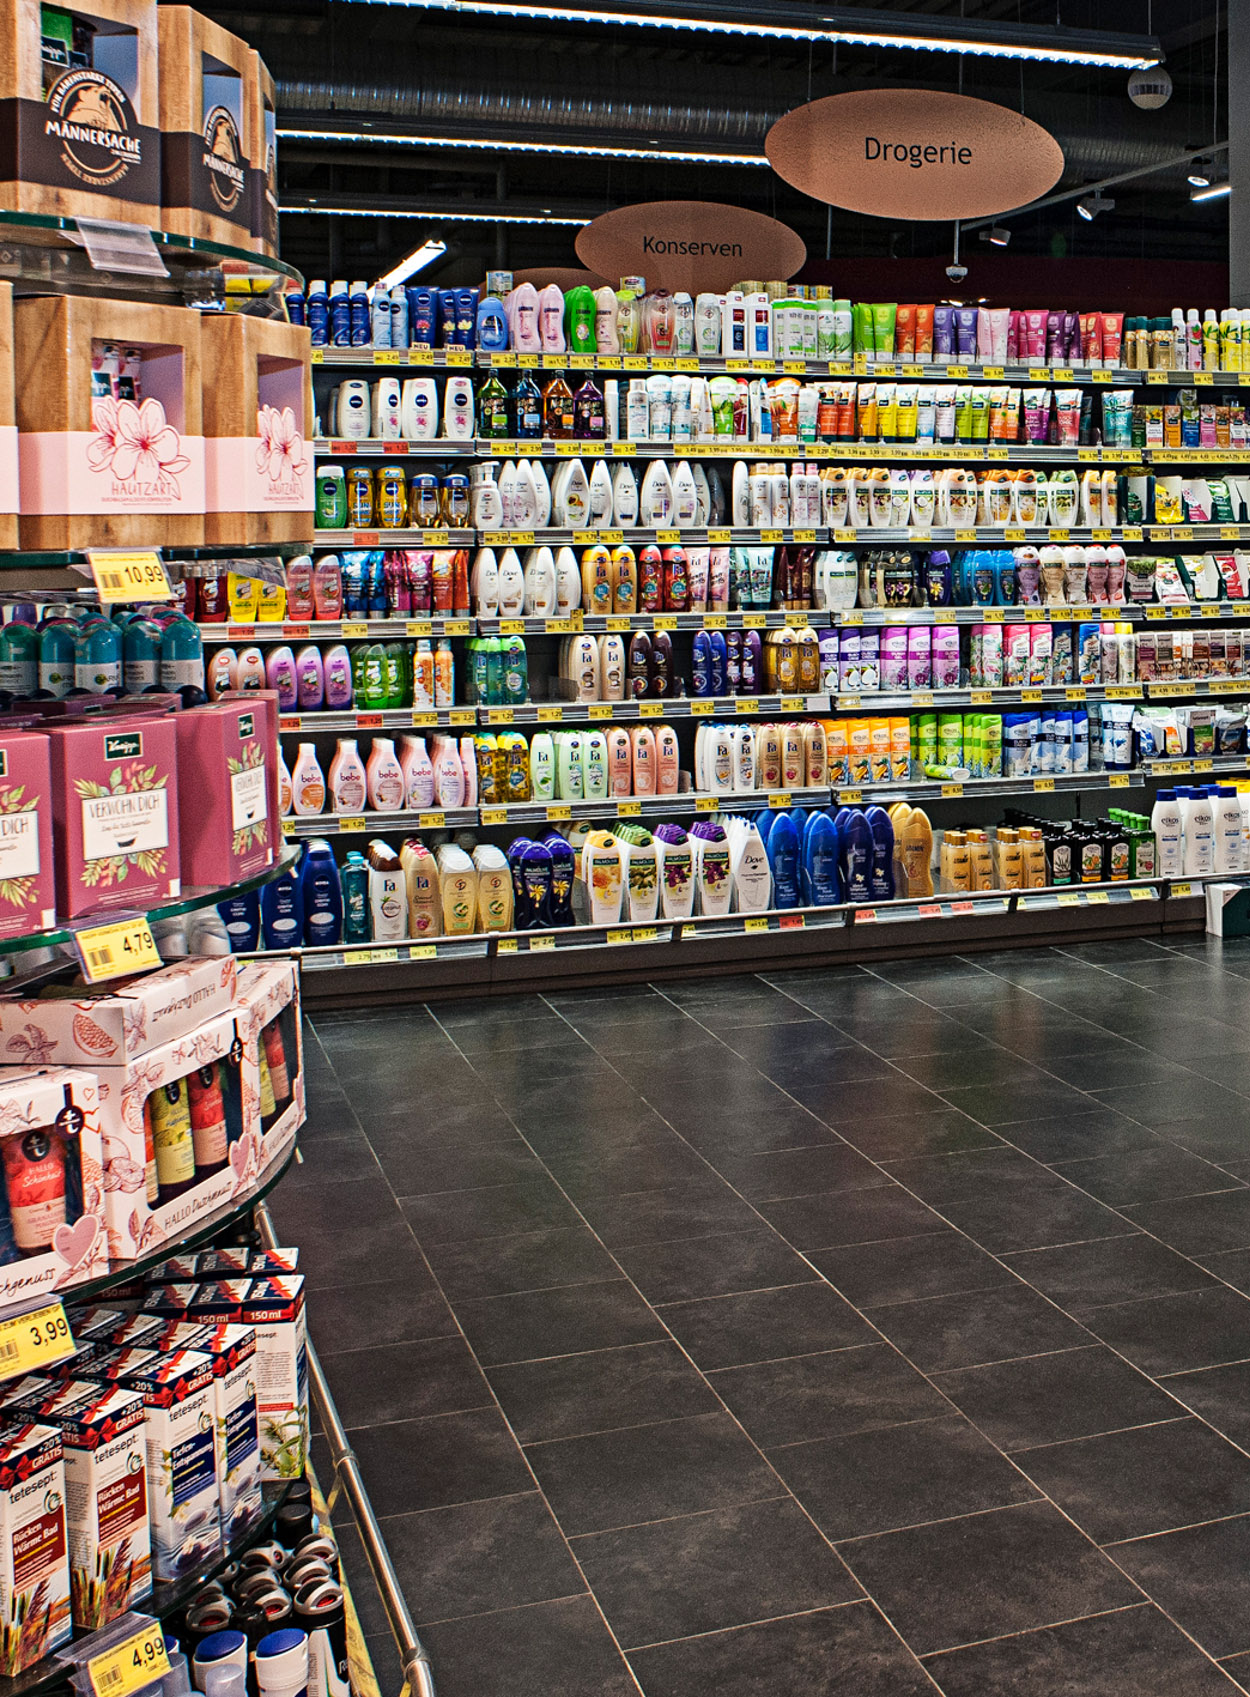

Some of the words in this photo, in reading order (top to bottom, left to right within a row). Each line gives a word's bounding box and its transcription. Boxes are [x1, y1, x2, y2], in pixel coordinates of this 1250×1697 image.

[45, 120, 141, 153] MÄNNERSACHE
[865, 137, 973, 168] Drogerie
[203, 153, 244, 183] MÄNNERSACHE
[643, 236, 742, 257] Konserven
[112, 481, 171, 495] HAUTZART
[124, 565, 164, 586] 10,99
[782, 648, 792, 658] Fa
[803, 647, 812, 657] Fa
[108, 740, 139, 753] Kneipp
[617, 749, 626, 759] Fa
[638, 749, 647, 759] Fa
[664, 746, 673, 756] Fa
[539, 752, 548, 761] Fa
[571, 752, 579, 761] Fa
[591, 751, 600, 760] Fa
[301, 774, 321, 782] bebe
[340, 773, 360, 781] bebe
[379, 770, 399, 778] bebe
[412, 768, 431, 776] bebe
[139, 794, 160, 812] DICH
[2, 818, 28, 835] DICH
[745, 855, 764, 864] Dove
[384, 879, 395, 892] Fa
[417, 876, 428, 889] Fa
[123, 932, 153, 954] 4,79
[164, 1207, 191, 1230] HALLO
[0, 1268, 56, 1297] chgenuss
[199, 1314, 214, 1324] 150
[250, 1311, 266, 1320] 150
[268, 1310, 281, 1319] ml
[30, 1318, 68, 1348] 3,99
[188, 1372, 213, 1390] GRATIS
[115, 1409, 145, 1431] GRATIS
[32, 1445, 62, 1469] GRATIS
[98, 1482, 125, 1502] Rücken
[125, 1482, 140, 1498] Bad
[13, 1522, 42, 1544] Rücken
[43, 1522, 58, 1539] Bad
[132, 1637, 165, 1667] 4,99
